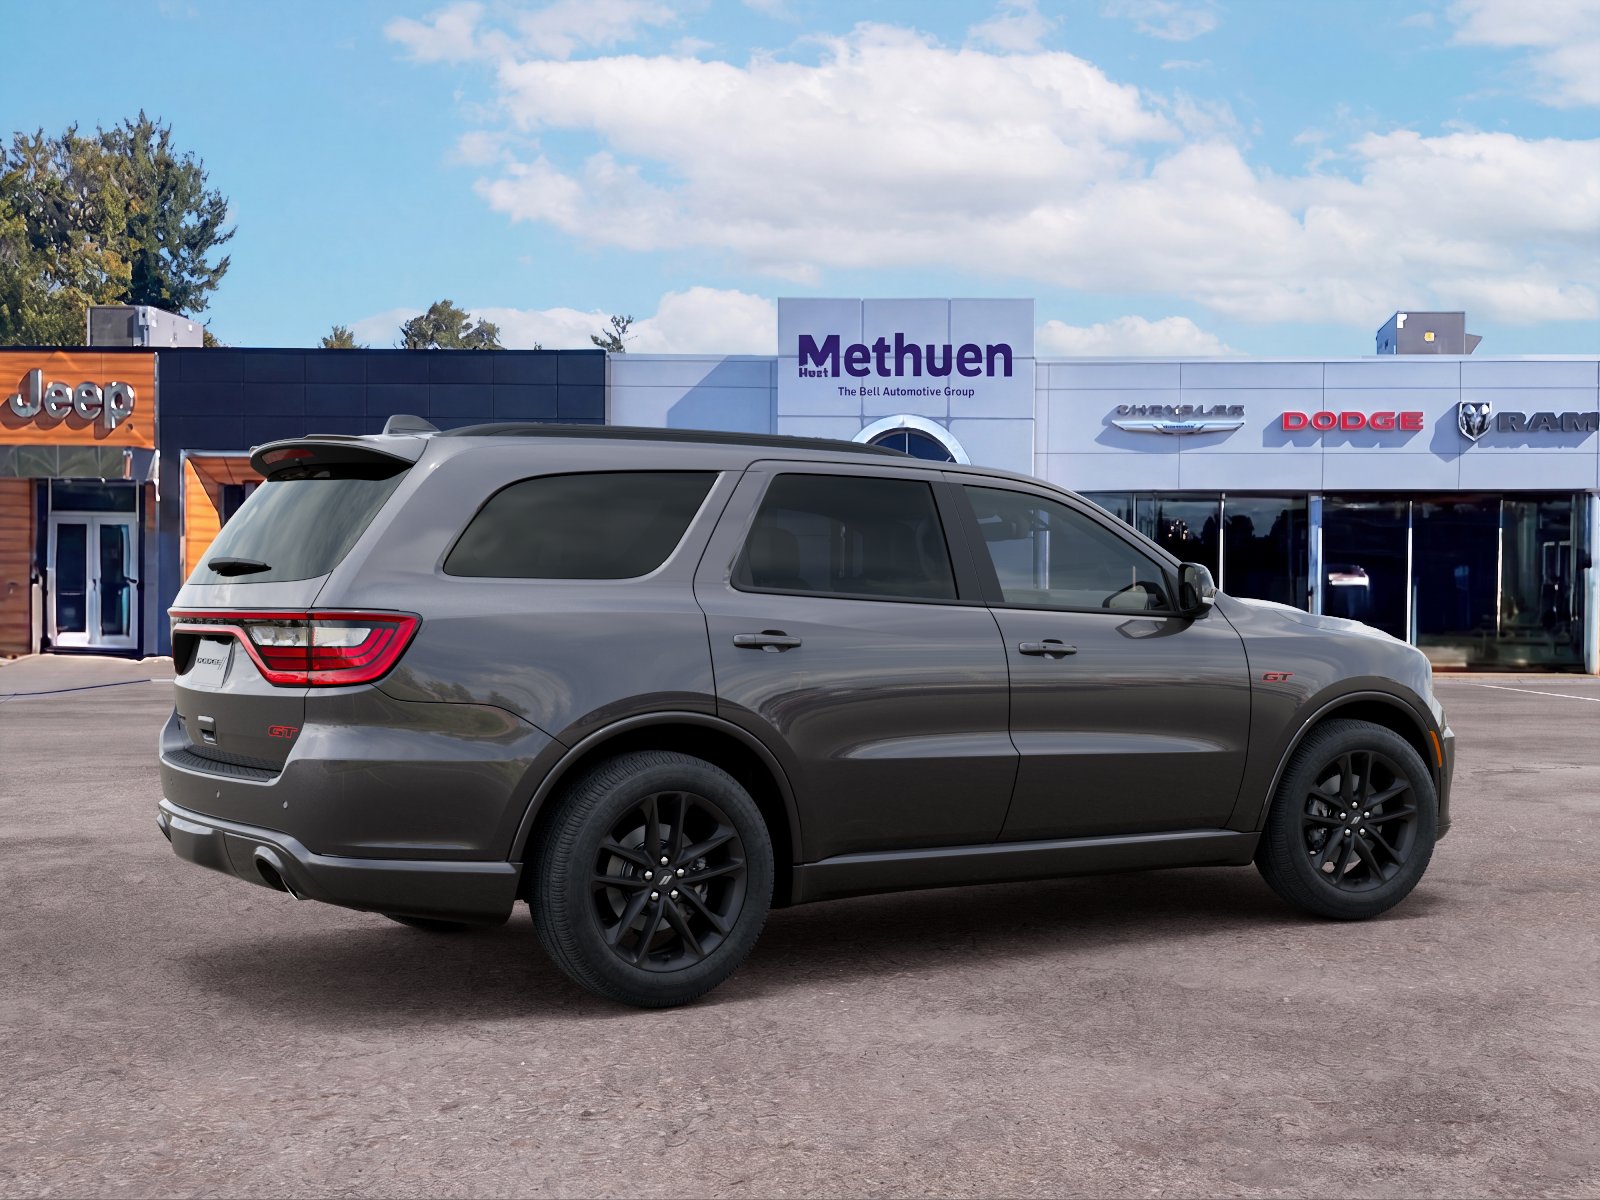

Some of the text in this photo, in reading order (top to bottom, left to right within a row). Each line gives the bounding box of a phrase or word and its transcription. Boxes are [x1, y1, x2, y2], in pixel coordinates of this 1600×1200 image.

[798, 332, 1013, 378] Methuen
[9, 368, 136, 429] Jeep
[838, 386, 975, 399] The Bell Automotive Group
[1282, 411, 1424, 430] DODGE
[1498, 411, 1599, 432] RAM
[1262, 672, 1294, 683] GT
[268, 725, 298, 739] GT
